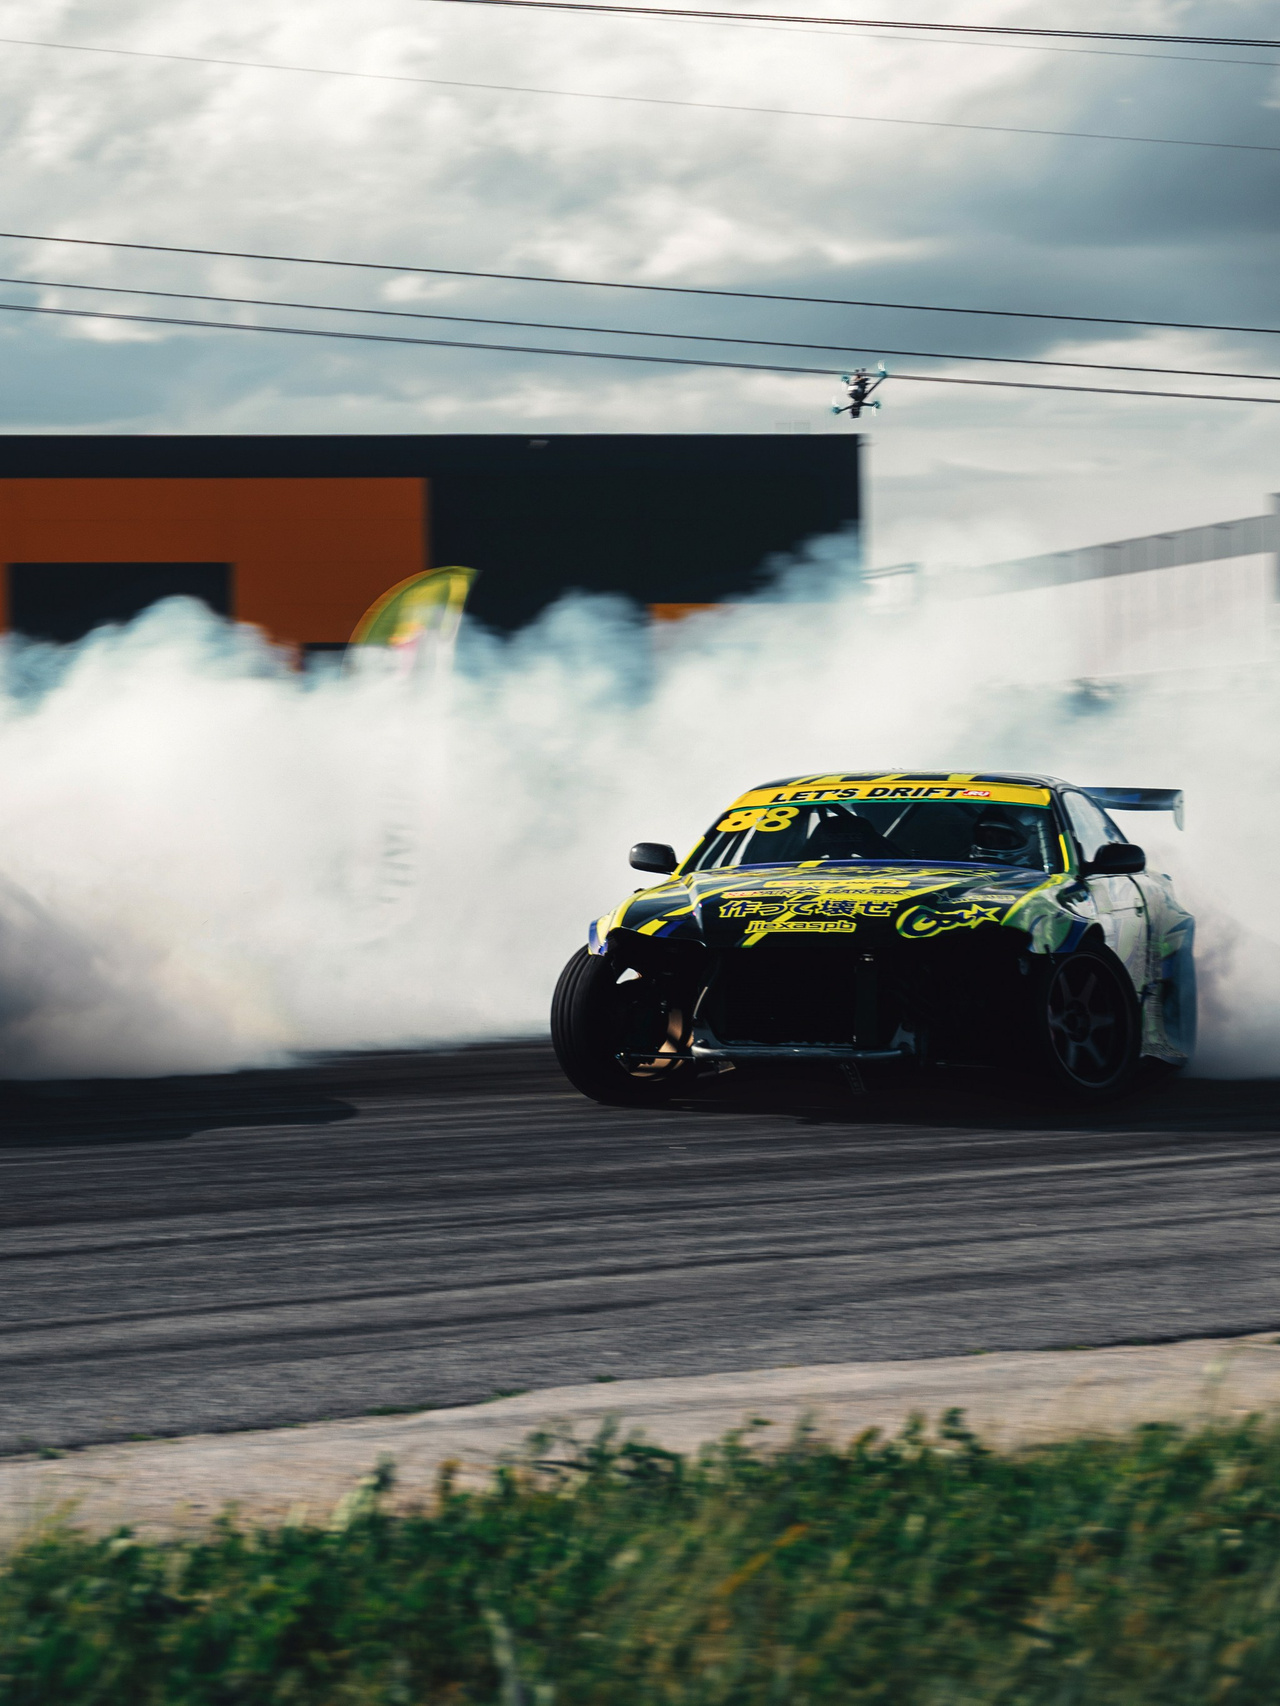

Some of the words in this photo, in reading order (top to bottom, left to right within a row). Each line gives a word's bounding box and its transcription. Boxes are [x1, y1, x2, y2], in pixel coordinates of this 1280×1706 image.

[770, 788, 860, 803] LET'S
[716, 806, 800, 832] 88
[719, 900, 898, 918] 作って壊せ
[746, 920, 856, 932] jiexaspb
